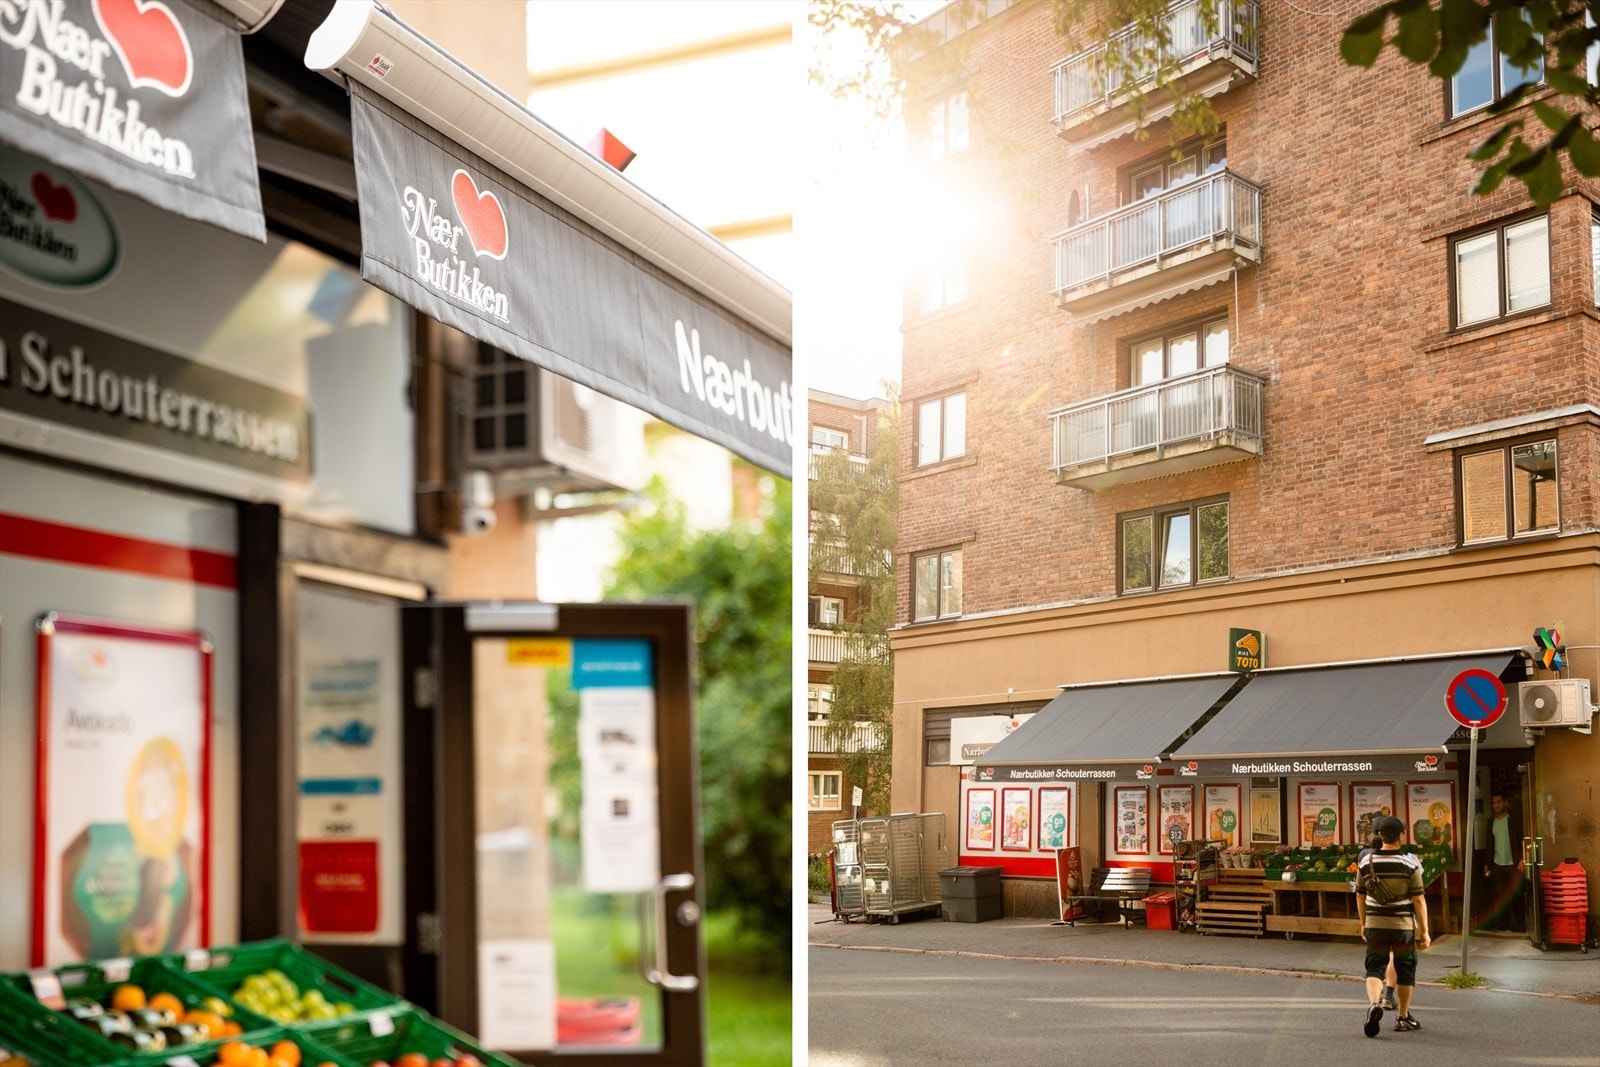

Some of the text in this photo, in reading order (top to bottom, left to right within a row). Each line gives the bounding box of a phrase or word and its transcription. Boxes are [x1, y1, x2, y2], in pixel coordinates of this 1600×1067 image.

[16, 44, 196, 179] Butikken
[402, 185, 464, 254] Nær
[413, 236, 510, 324] Butikken
[19, 329, 299, 464] Schouterrassen
[674, 319, 792, 448] Nærbut
[1236, 656, 1259, 669] TOTO
[1010, 768, 1116, 779] Nærbutikken Schouterrassen
[1231, 760, 1373, 774] Nærbutikken Schouterrassen
